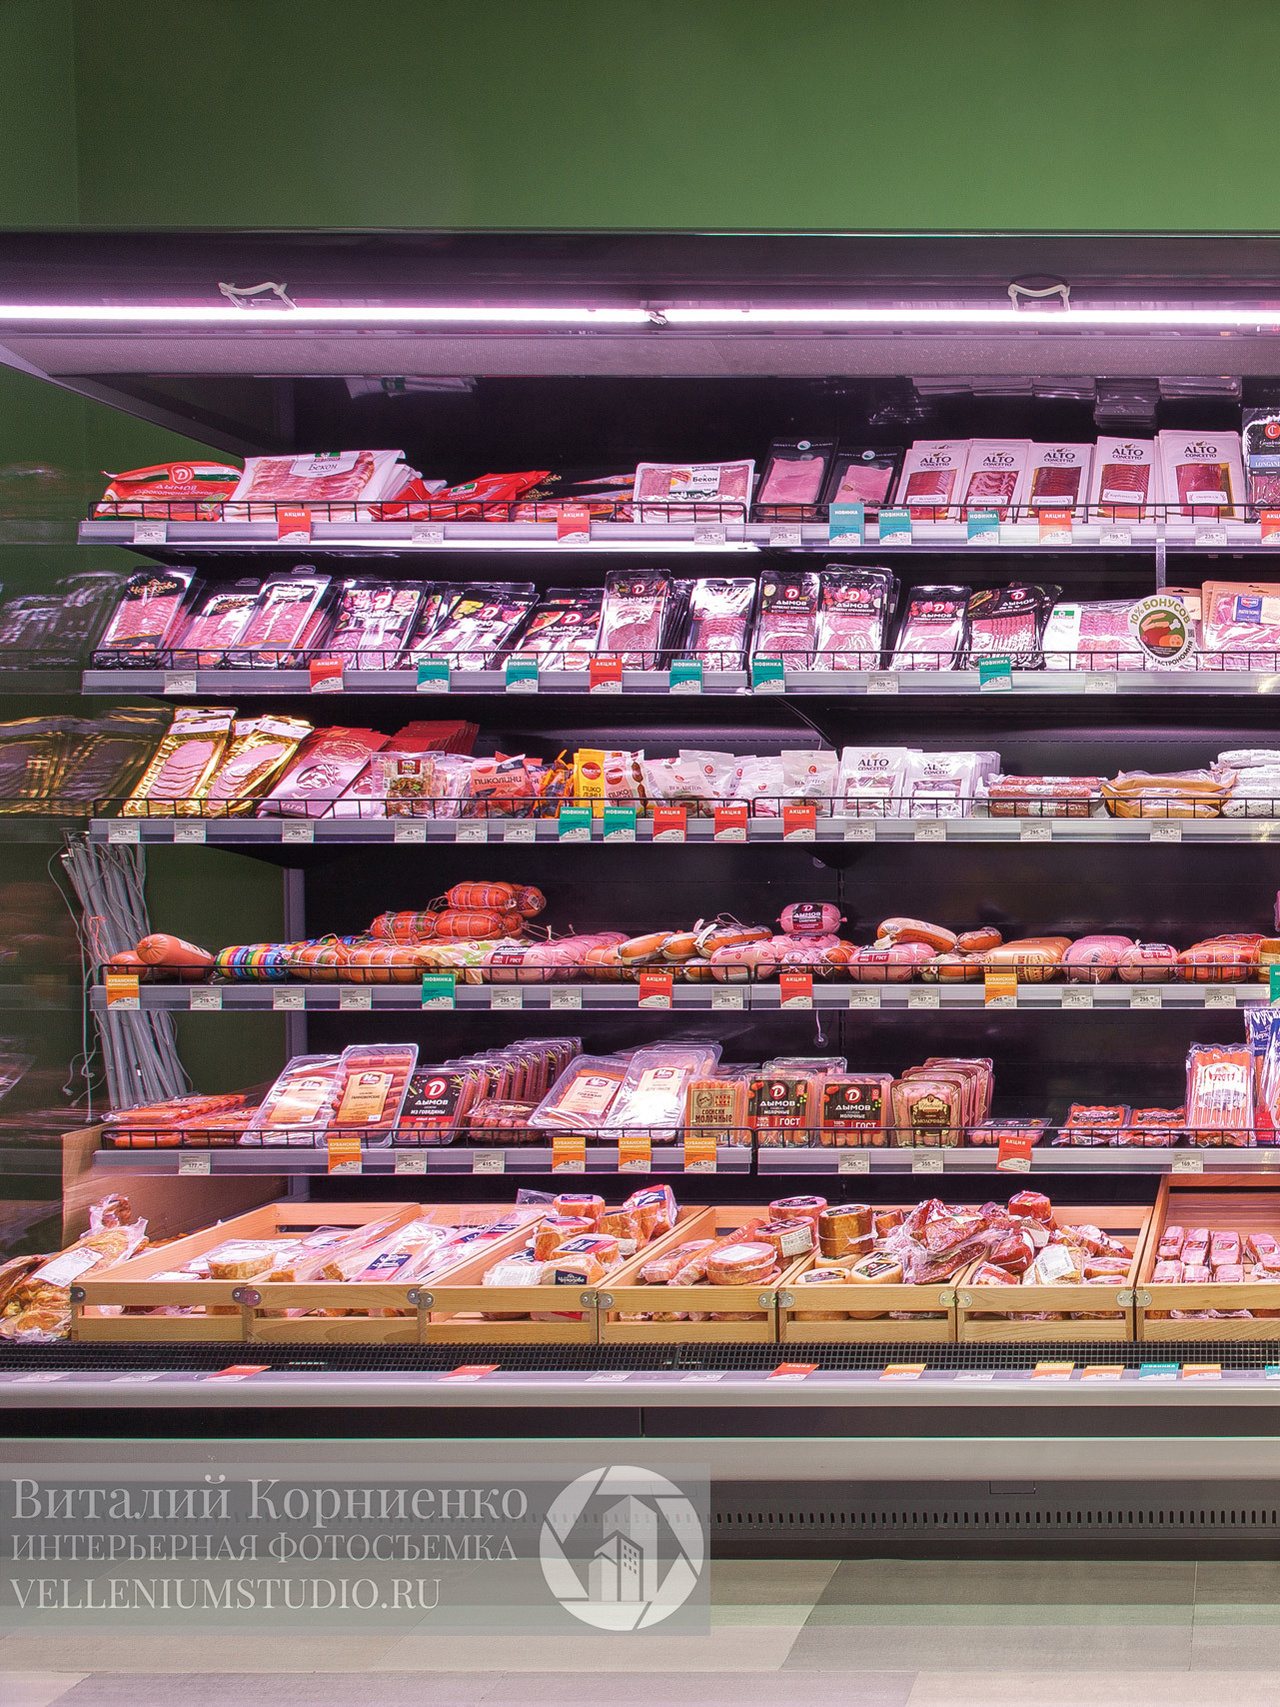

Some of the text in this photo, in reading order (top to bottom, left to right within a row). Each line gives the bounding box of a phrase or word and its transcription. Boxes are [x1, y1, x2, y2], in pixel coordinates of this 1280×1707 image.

[1112, 448, 1143, 457] ALTO
[1184, 446, 1217, 455] ALTO
[920, 456, 951, 464] ALTO
[983, 457, 1014, 465] ALTO
[1044, 452, 1075, 461] ALTO
[1130, 598, 1191, 625] 10% БОНУСОВ
[859, 759, 889, 767] ALTO
[779, 1116, 801, 1125] ГОСТ
[1005, 1138, 1027, 1146] АКЦИЯ
